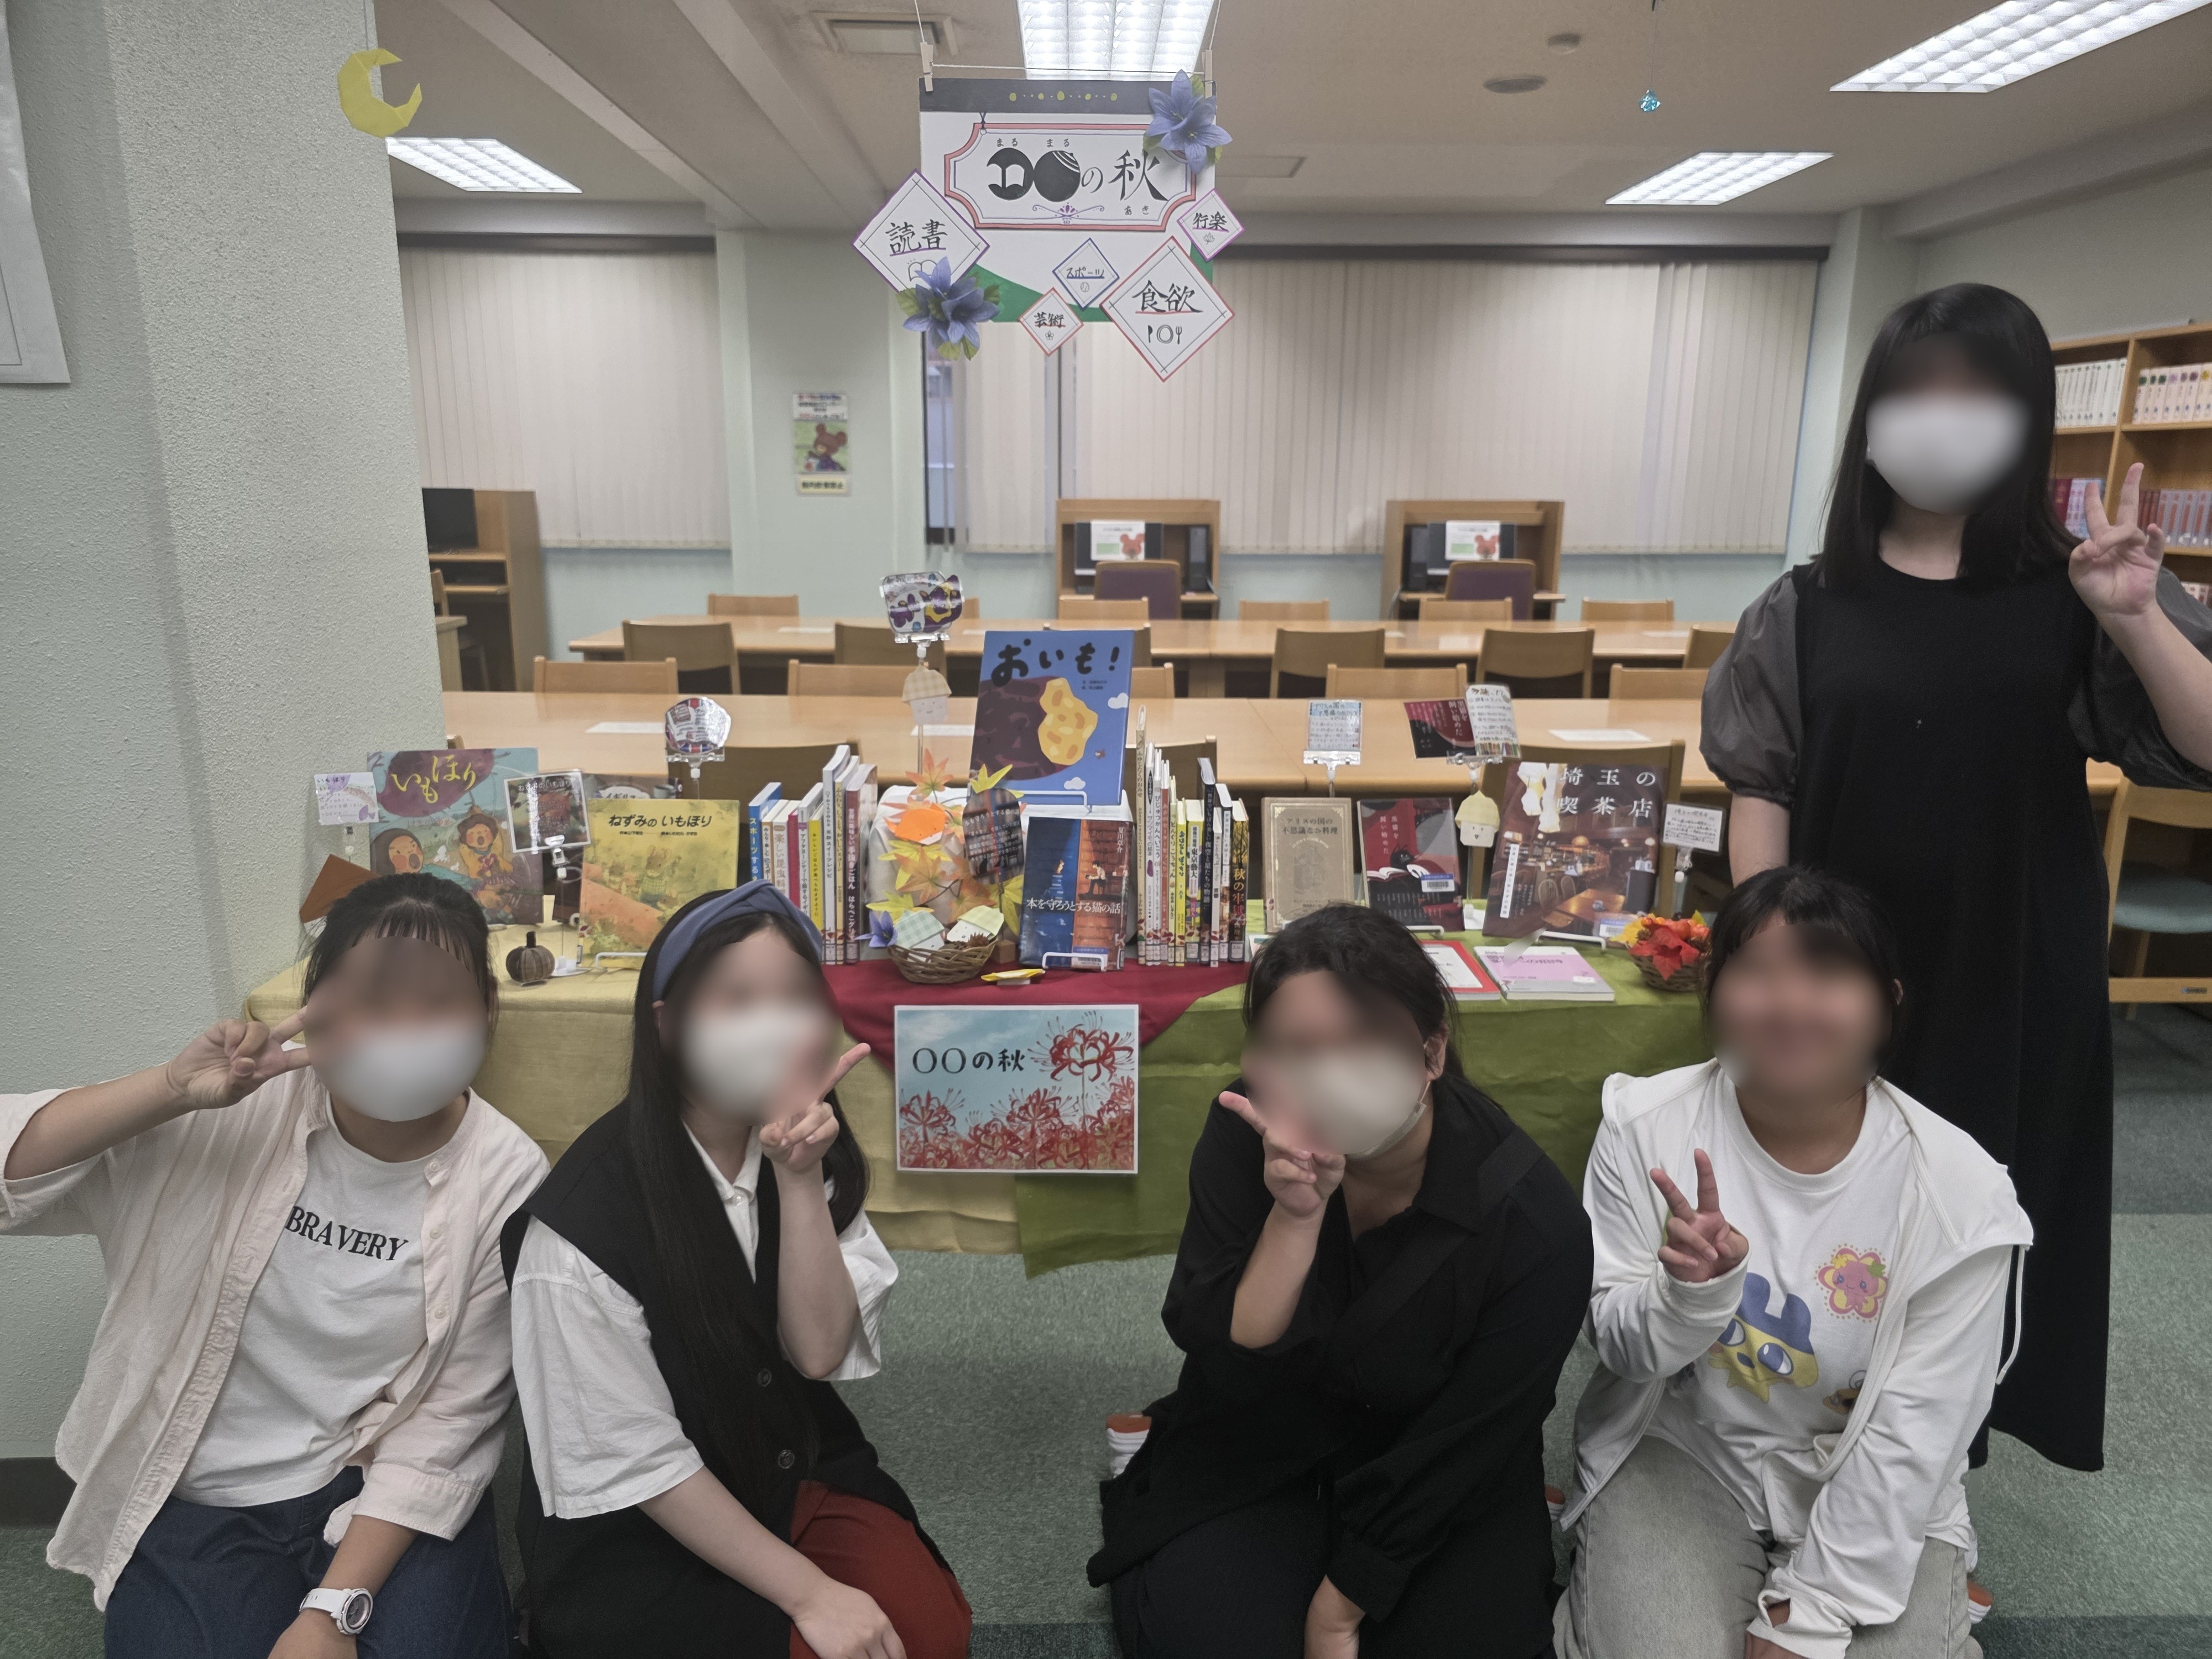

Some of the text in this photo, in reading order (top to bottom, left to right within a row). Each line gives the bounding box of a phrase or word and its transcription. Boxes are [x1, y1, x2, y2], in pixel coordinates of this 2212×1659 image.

[1124, 206, 1150, 215] あき
[1193, 212, 1230, 231] 行楽
[886, 219, 948, 254] 読書
[1066, 267, 1105, 278] スポーツ
[1132, 279, 1203, 313] 食欲
[1034, 311, 1066, 327] 芸術
[392, 754, 476, 804] いもほり
[1563, 768, 1656, 786] 埼玉の
[1556, 796, 1653, 818] 喫茶店
[608, 814, 712, 828] ねずみの いもほり
[1026, 898, 1121, 914] 本を守ろうとする猫の話
[284, 1206, 409, 1261] BRAVERY
